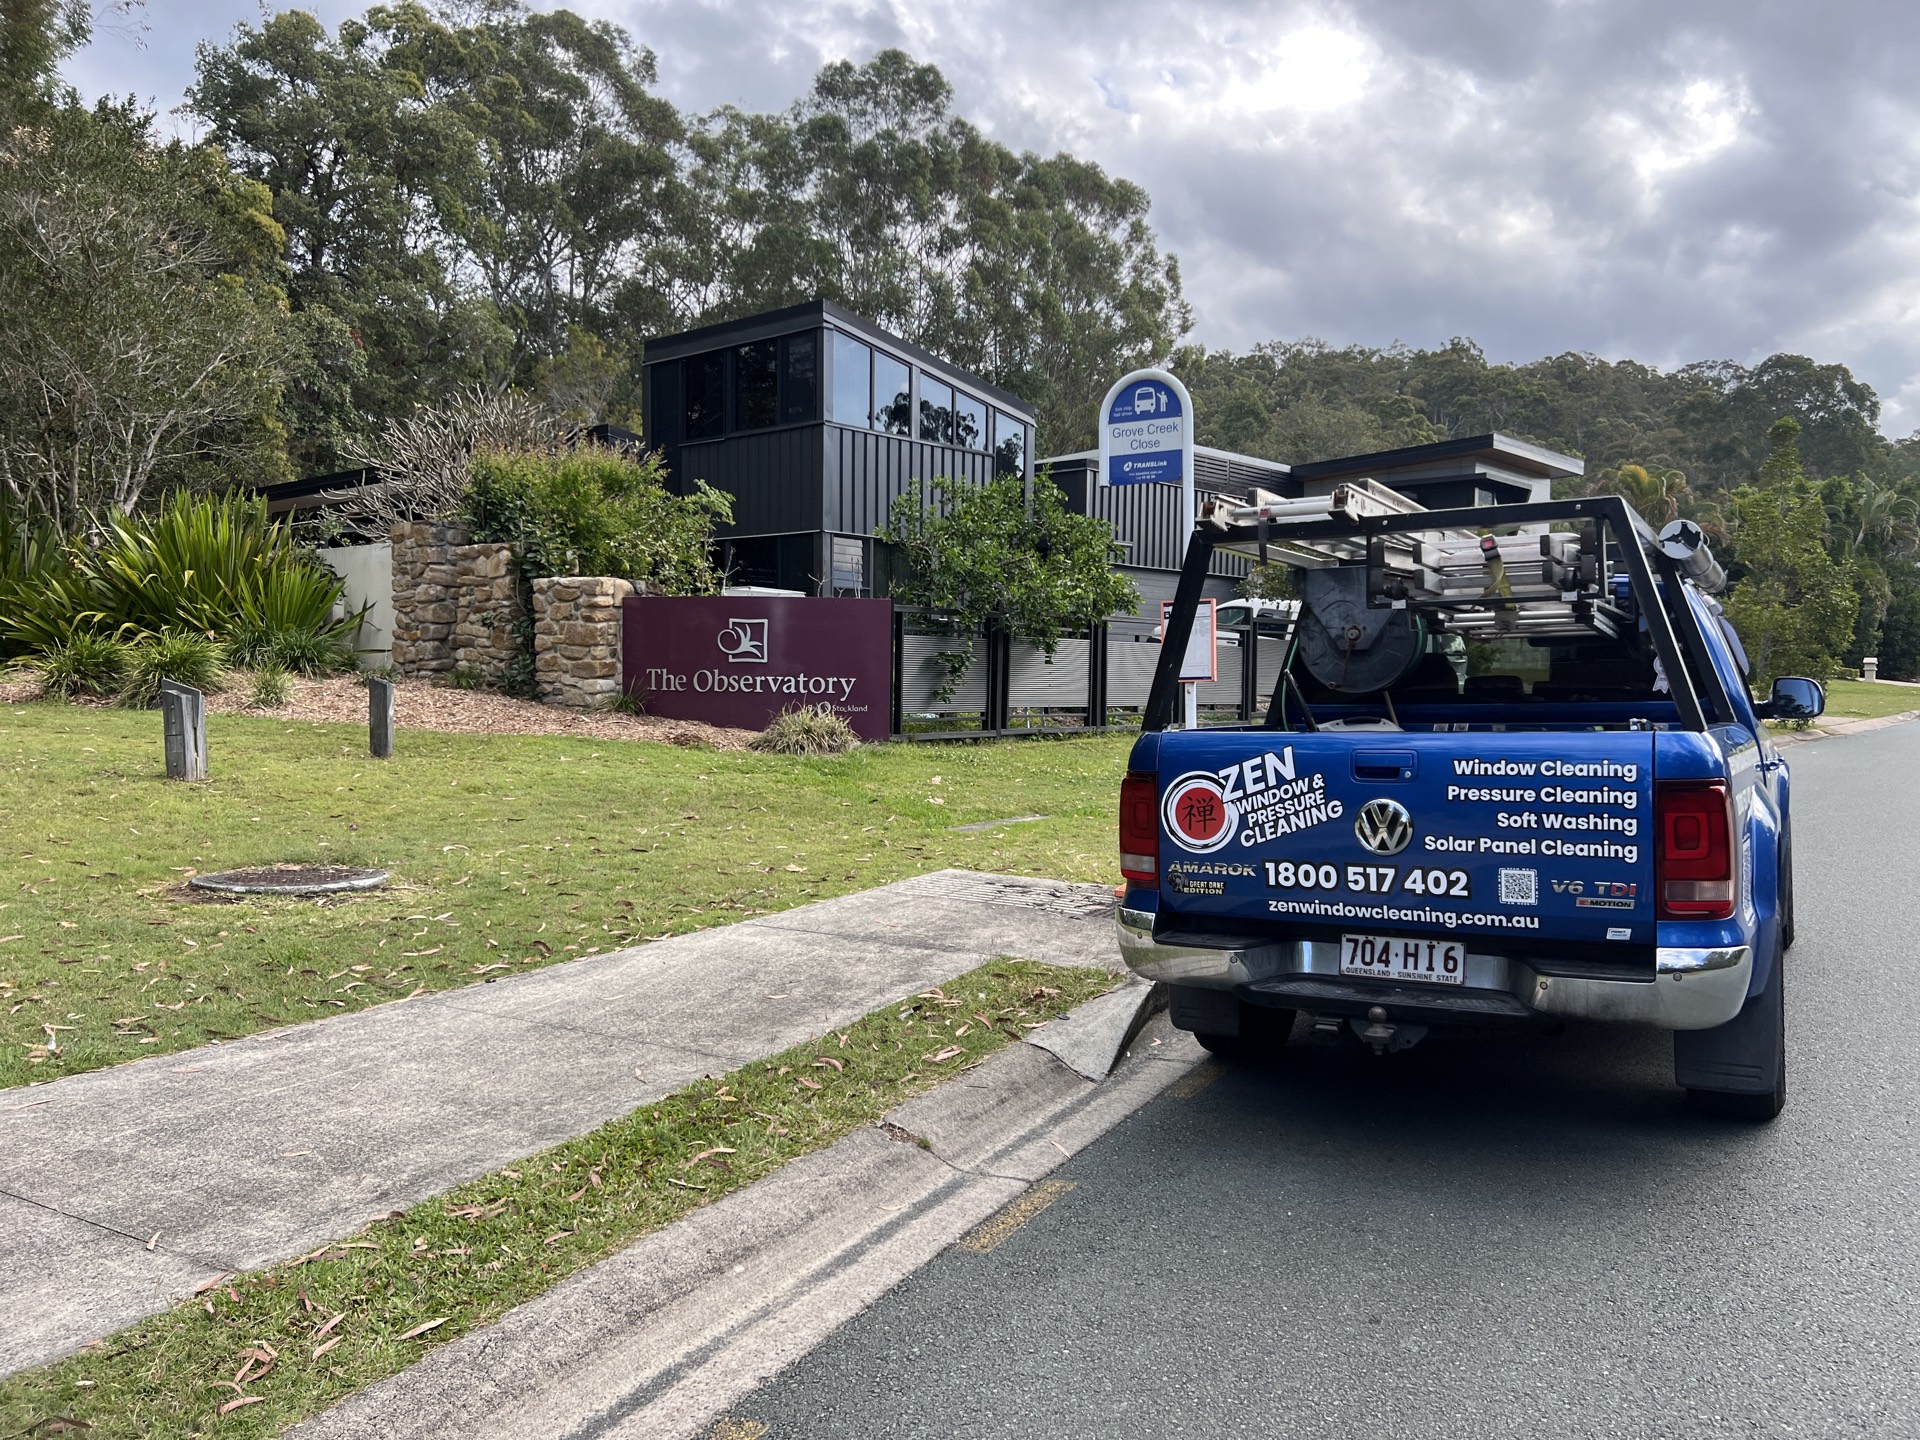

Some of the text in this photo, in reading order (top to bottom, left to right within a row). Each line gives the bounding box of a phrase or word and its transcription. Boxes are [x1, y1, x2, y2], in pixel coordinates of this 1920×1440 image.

[1112, 422, 1179, 438] Grove Creek
[1130, 439, 1160, 450] Close
[646, 668, 857, 701] The Observatory
[1218, 746, 1296, 802] ZEN
[1453, 759, 1637, 782] Window Cleaning
[1236, 773, 1325, 814] WINDOW &
[1447, 786, 1637, 809] Pressure Cleaning
[1247, 789, 1325, 827] PRESSURE
[1240, 800, 1343, 847] CLEANING
[1497, 812, 1637, 836] Soft Washing
[1424, 835, 1637, 863] Solar Panel Cleaning
[1168, 860, 1257, 876] AMAROK
[1265, 862, 1337, 889] 1800
[1347, 866, 1395, 892] 517
[1404, 869, 1468, 896] 402
[1183, 887, 1223, 895] EDITION
[1551, 880, 1584, 894] V6
[1594, 881, 1637, 897] TDI
[1269, 900, 1539, 929] zenwindowcleaning.com.au
[1346, 967, 1390, 976] QUEENSLAND
[1397, 971, 1432, 980] SUNSHINE
[1436, 974, 1457, 983] STATE
